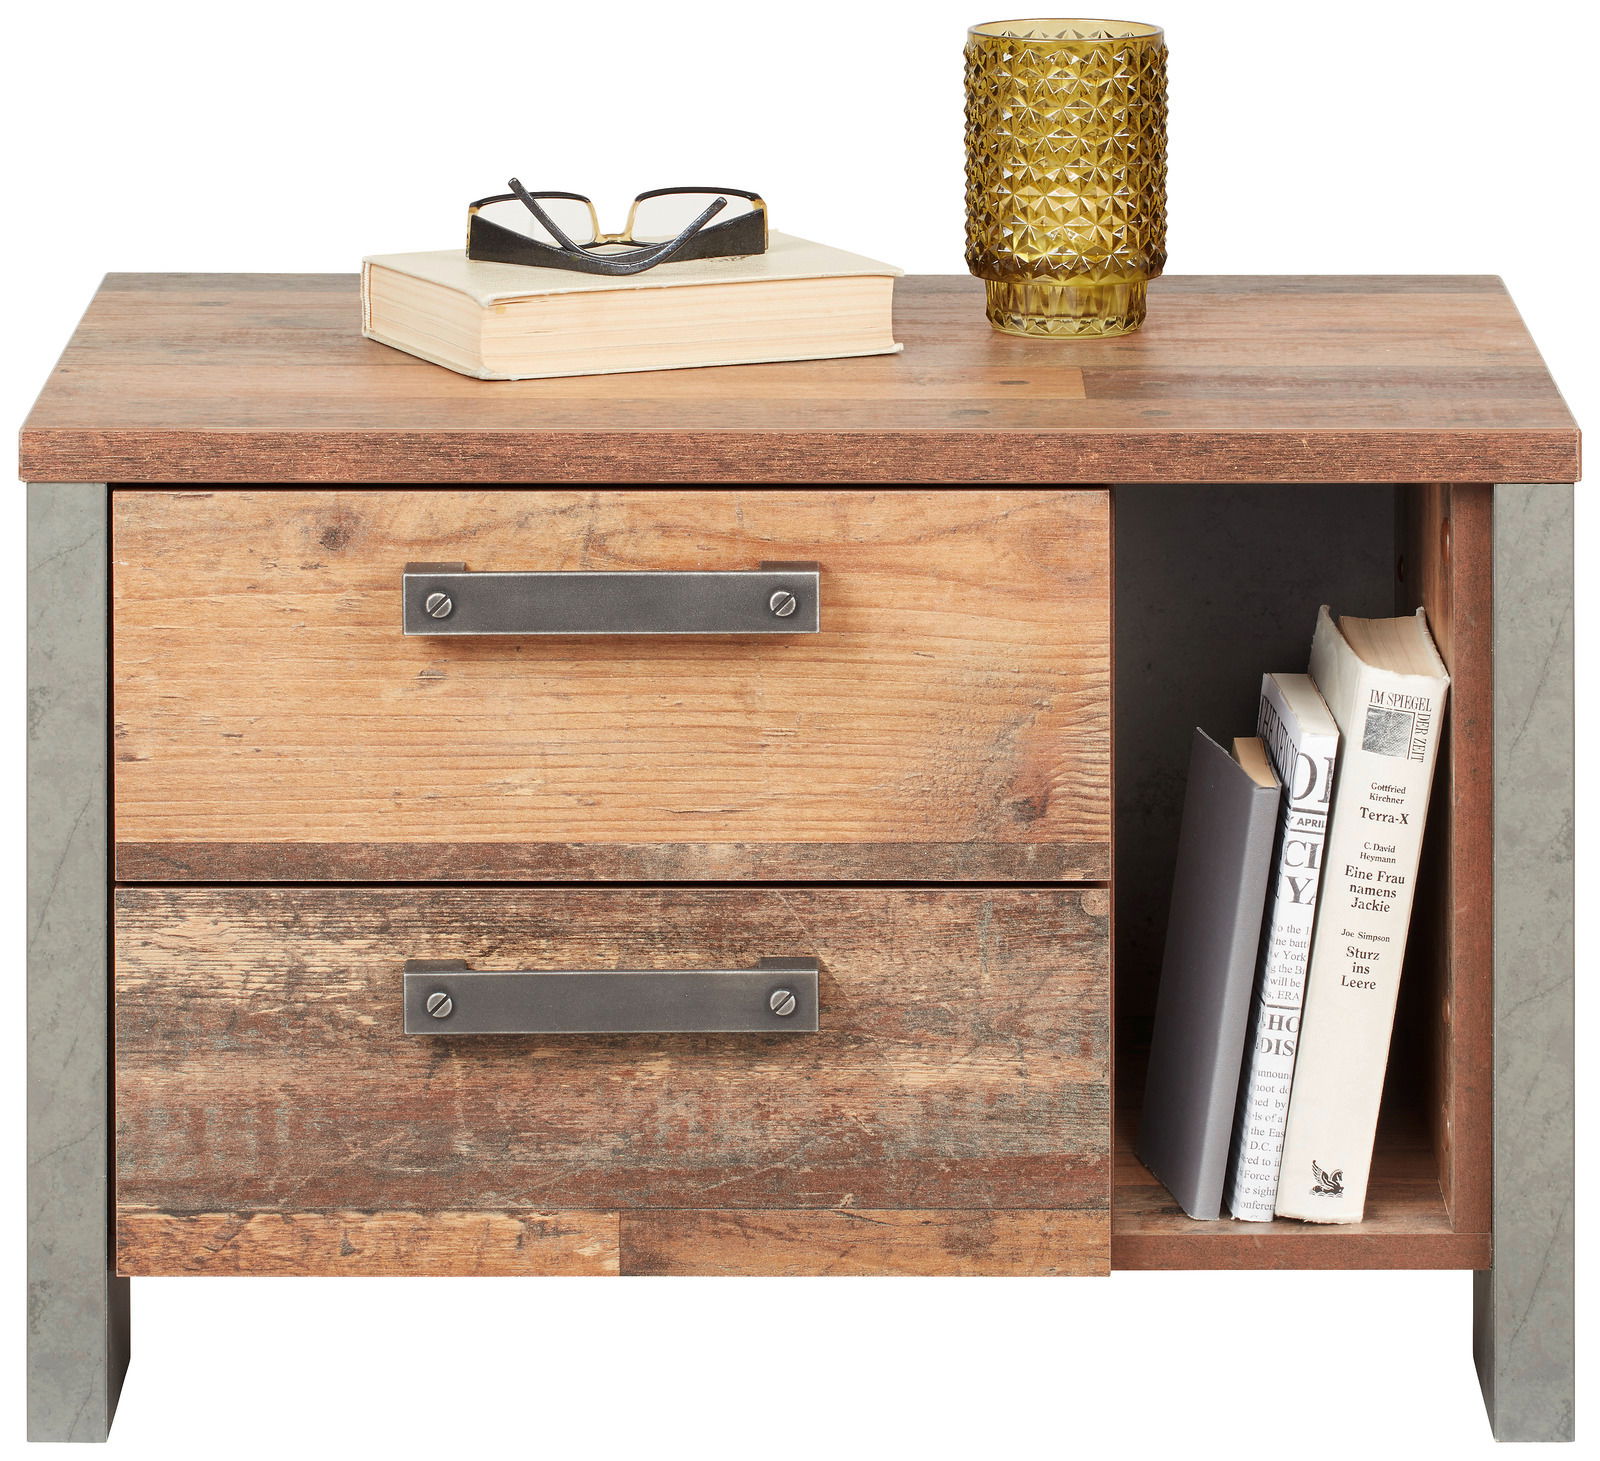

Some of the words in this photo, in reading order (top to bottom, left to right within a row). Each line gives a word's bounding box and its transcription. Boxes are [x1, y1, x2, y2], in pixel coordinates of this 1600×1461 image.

[1369, 689, 1385, 705] IM
[1386, 692, 1432, 712] SPIEGEL
[1414, 713, 1431, 736] DER
[1410, 738, 1427, 763] ZEIT
[1371, 782, 1407, 795] Gottfried
[1369, 793, 1405, 805] Kirchner
[1360, 806, 1410, 825] Terra-X
[1363, 841, 1372, 850] C.
[1373, 843, 1396, 853] David
[1360, 852, 1397, 864] Heymann
[1345, 864, 1373, 881] Eine
[1377, 870, 1405, 885] Frau
[1349, 884, 1397, 899] namens
[1350, 897, 1391, 913] Jackie
[1286, 924, 1302, 935] the
[1341, 928, 1355, 938] Joe
[1357, 931, 1391, 943] Simpson
[1283, 950, 1307, 962] York
[1346, 945, 1380, 961] Sturz
[1278, 963, 1293, 974] the
[1352, 961, 1371, 975] ins
[1270, 976, 1288, 987] will
[1289, 978, 1301, 988] be
[1341, 974, 1377, 990] Leere
[1274, 1099, 1287, 1111] by
[1250, 1126, 1265, 1137] the
[1261, 1158, 1272, 1167] to
[1243, 1170, 1271, 1182] Force
